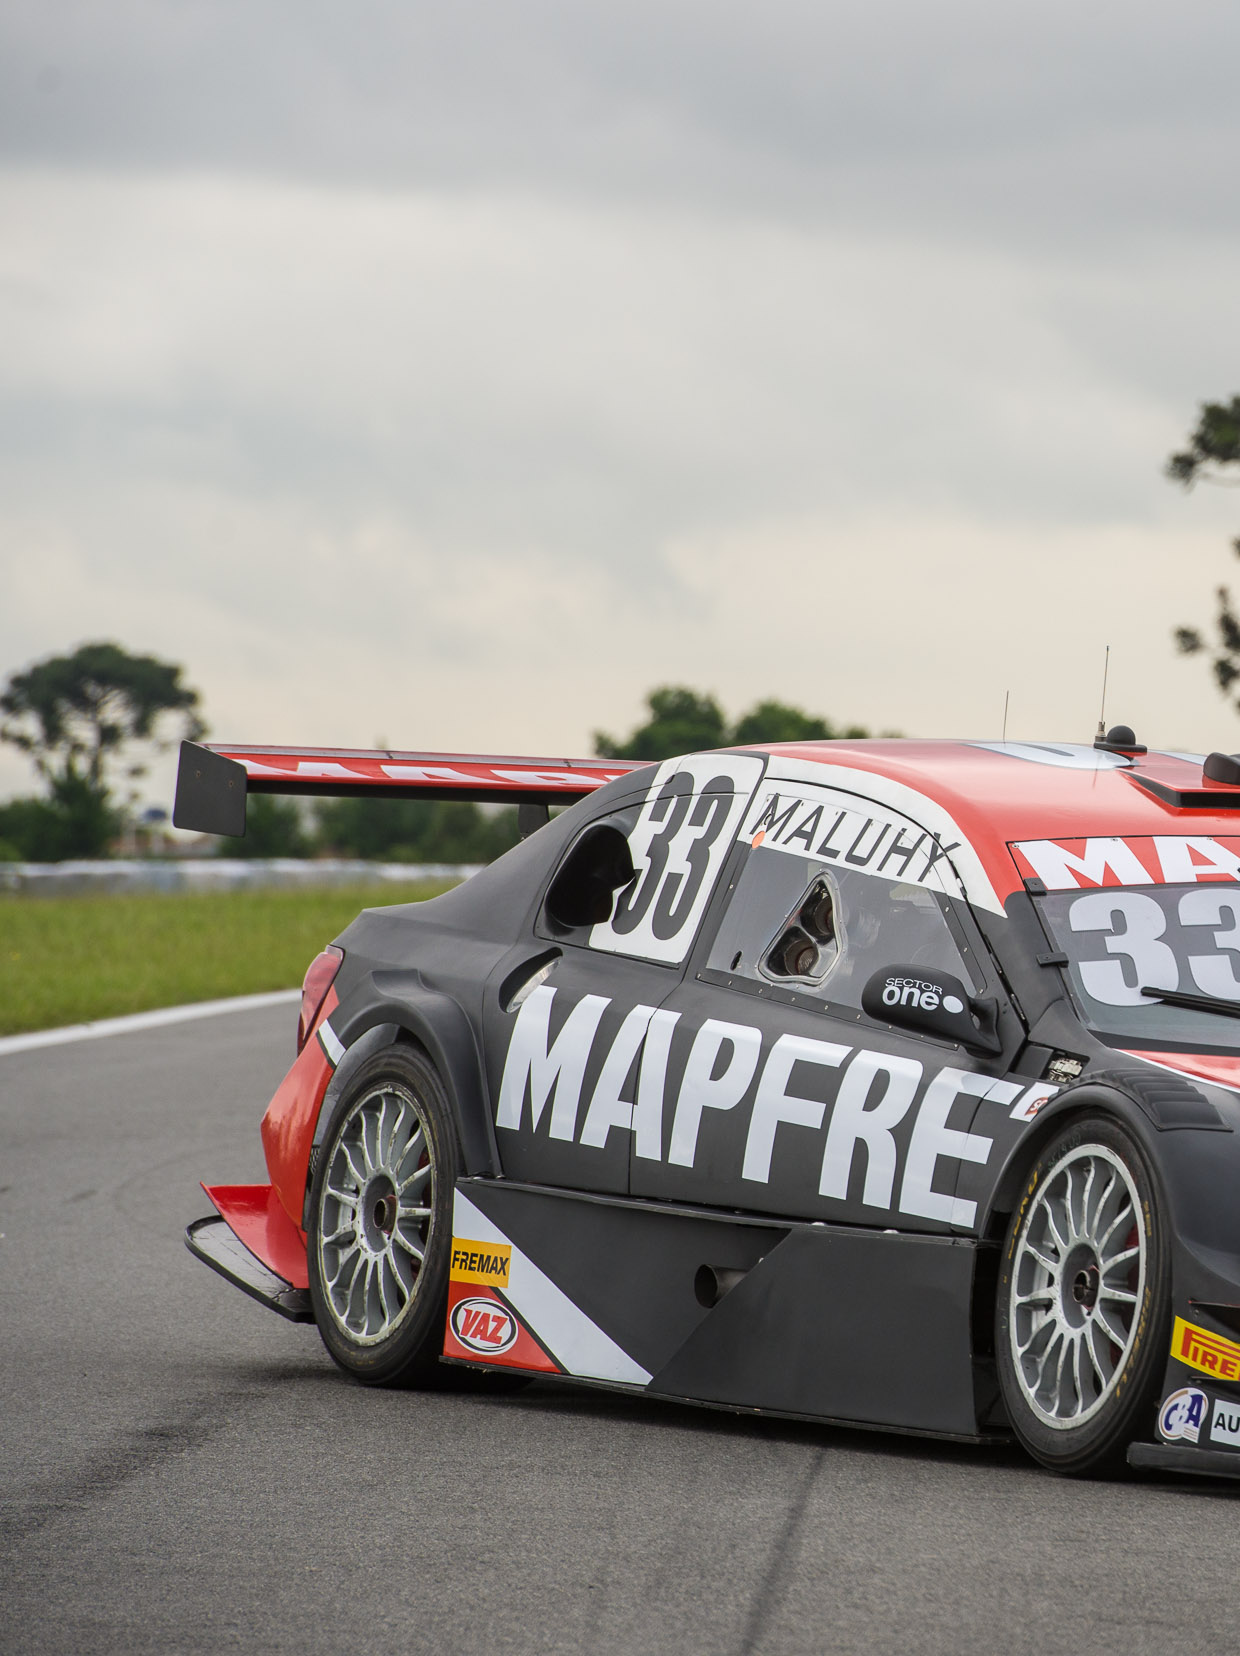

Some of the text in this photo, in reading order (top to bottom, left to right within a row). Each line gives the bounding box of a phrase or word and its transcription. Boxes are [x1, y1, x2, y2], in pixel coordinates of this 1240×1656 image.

[612, 772, 724, 940] 33
[749, 793, 961, 882] MALUHY
[882, 986, 940, 1011] one
[885, 977, 943, 995] SECTOR
[495, 984, 1027, 1229] MAPFRE
[452, 1250, 509, 1276] FREMAX
[460, 1307, 509, 1345] VAZ
[1164, 1393, 1204, 1432] CBA
